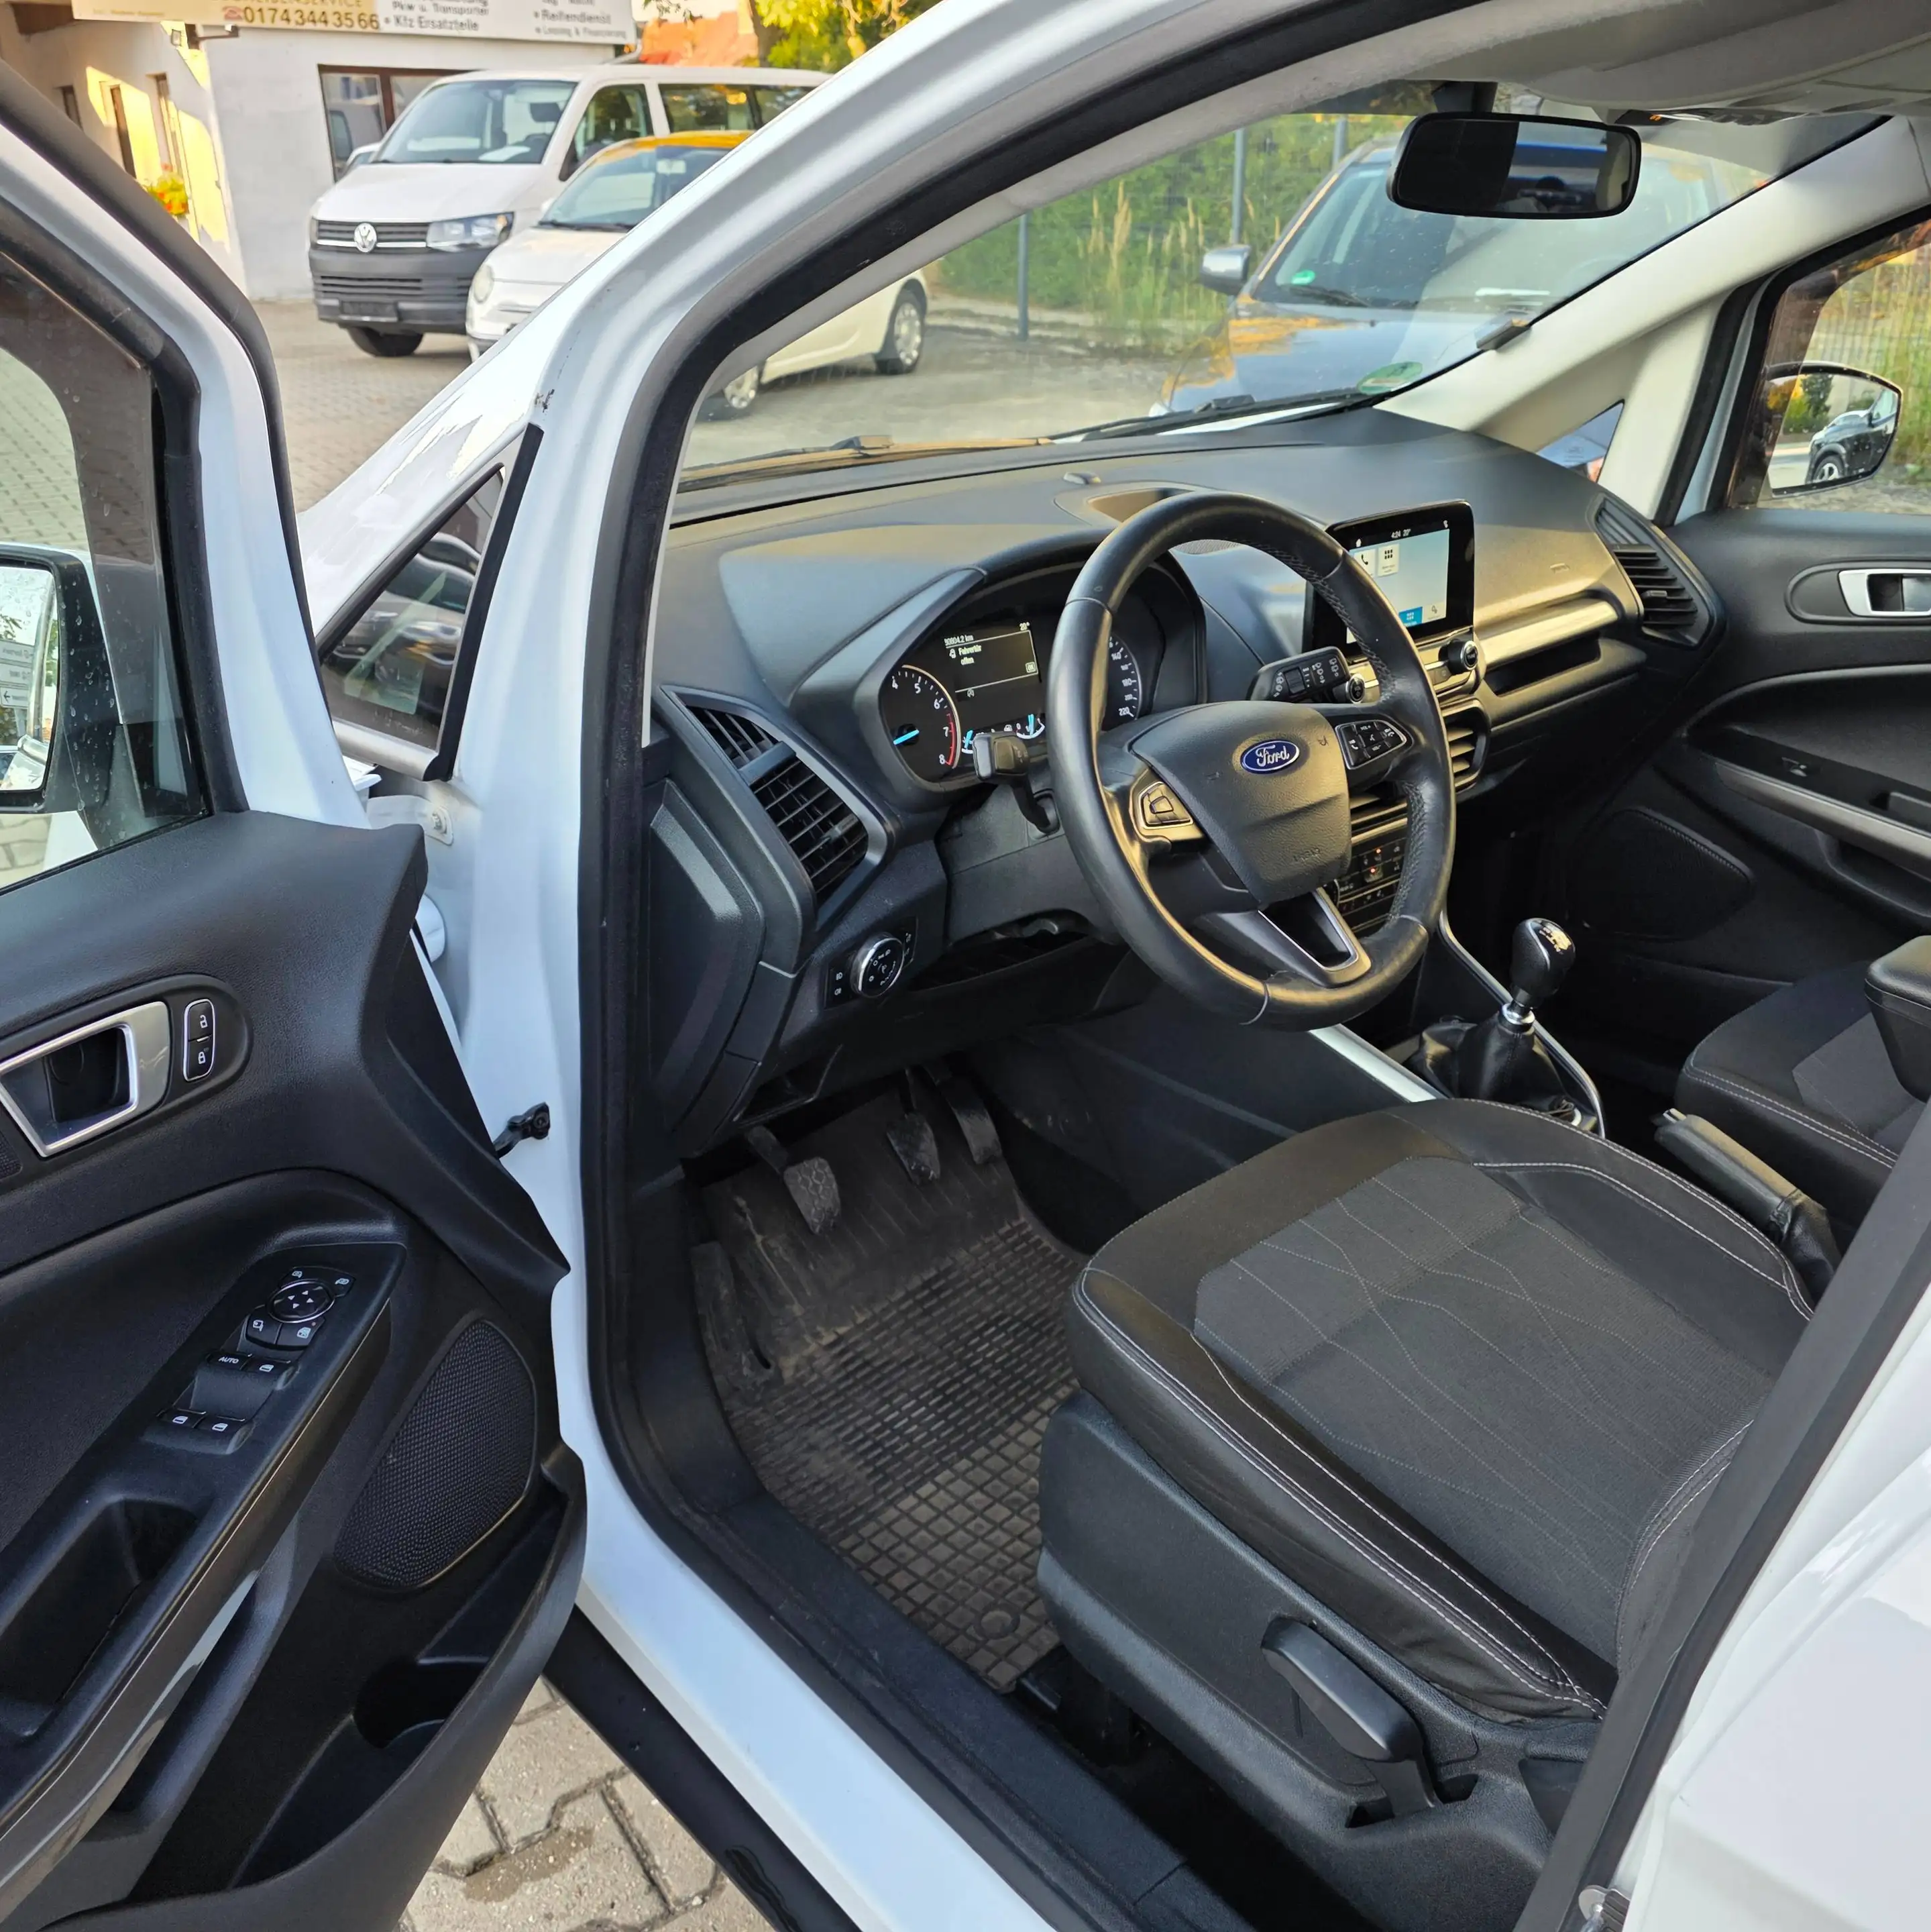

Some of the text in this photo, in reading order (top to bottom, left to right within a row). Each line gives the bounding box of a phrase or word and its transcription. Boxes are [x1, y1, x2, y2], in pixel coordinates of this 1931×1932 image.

[541, 9, 611, 23] Reifendienst
[418, 16, 479, 31] Ersatzteile
[914, 683, 921, 694] 5
[934, 698, 940, 710] 6
[942, 726, 949, 737] 7
[939, 753, 946, 765] 8
[1256, 744, 1290, 767] Ford
